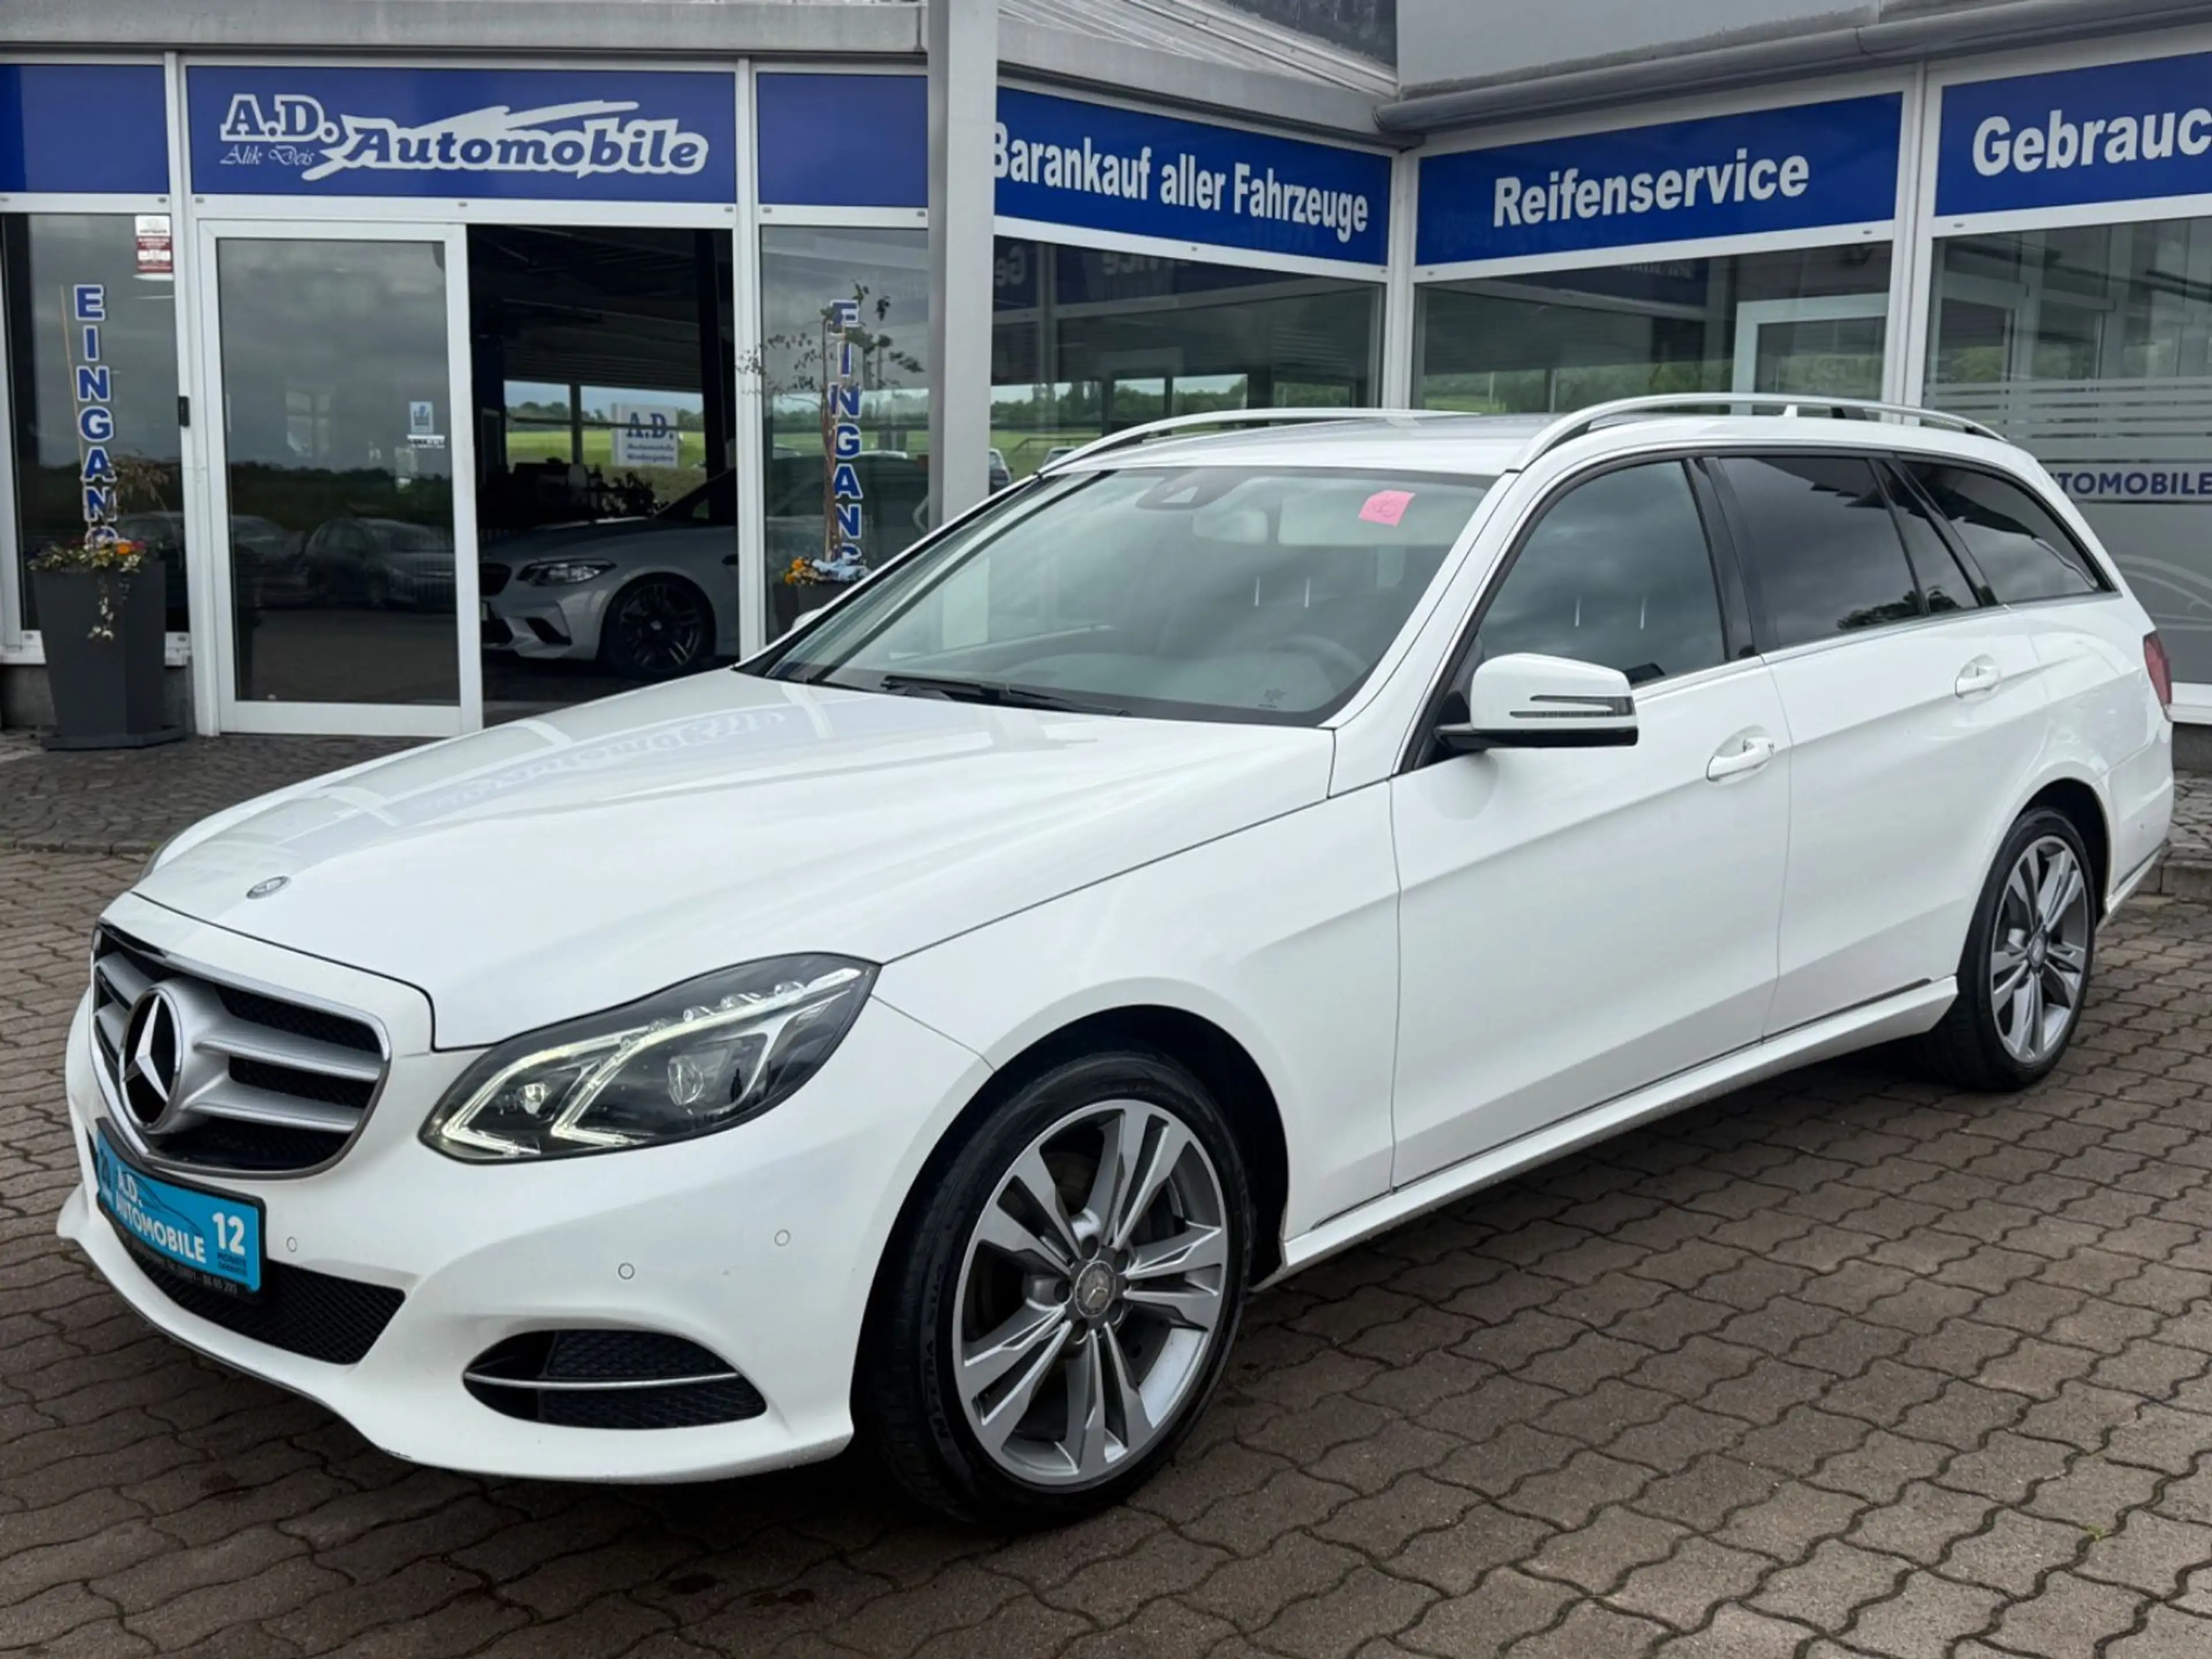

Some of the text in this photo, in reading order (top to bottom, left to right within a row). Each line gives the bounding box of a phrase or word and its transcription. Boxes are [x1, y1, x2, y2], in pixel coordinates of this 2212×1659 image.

[220, 94, 709, 174] A.D. Automobile
[1972, 108, 2212, 176] Gebrauc
[992, 121, 1369, 243] Barankauf aller Fahrzeuge
[1493, 148, 1809, 228] Reifenservice
[626, 411, 674, 440] A.D.
[2049, 472, 2212, 495] TOMOBILE
[212, 1212, 245, 1256] 12
